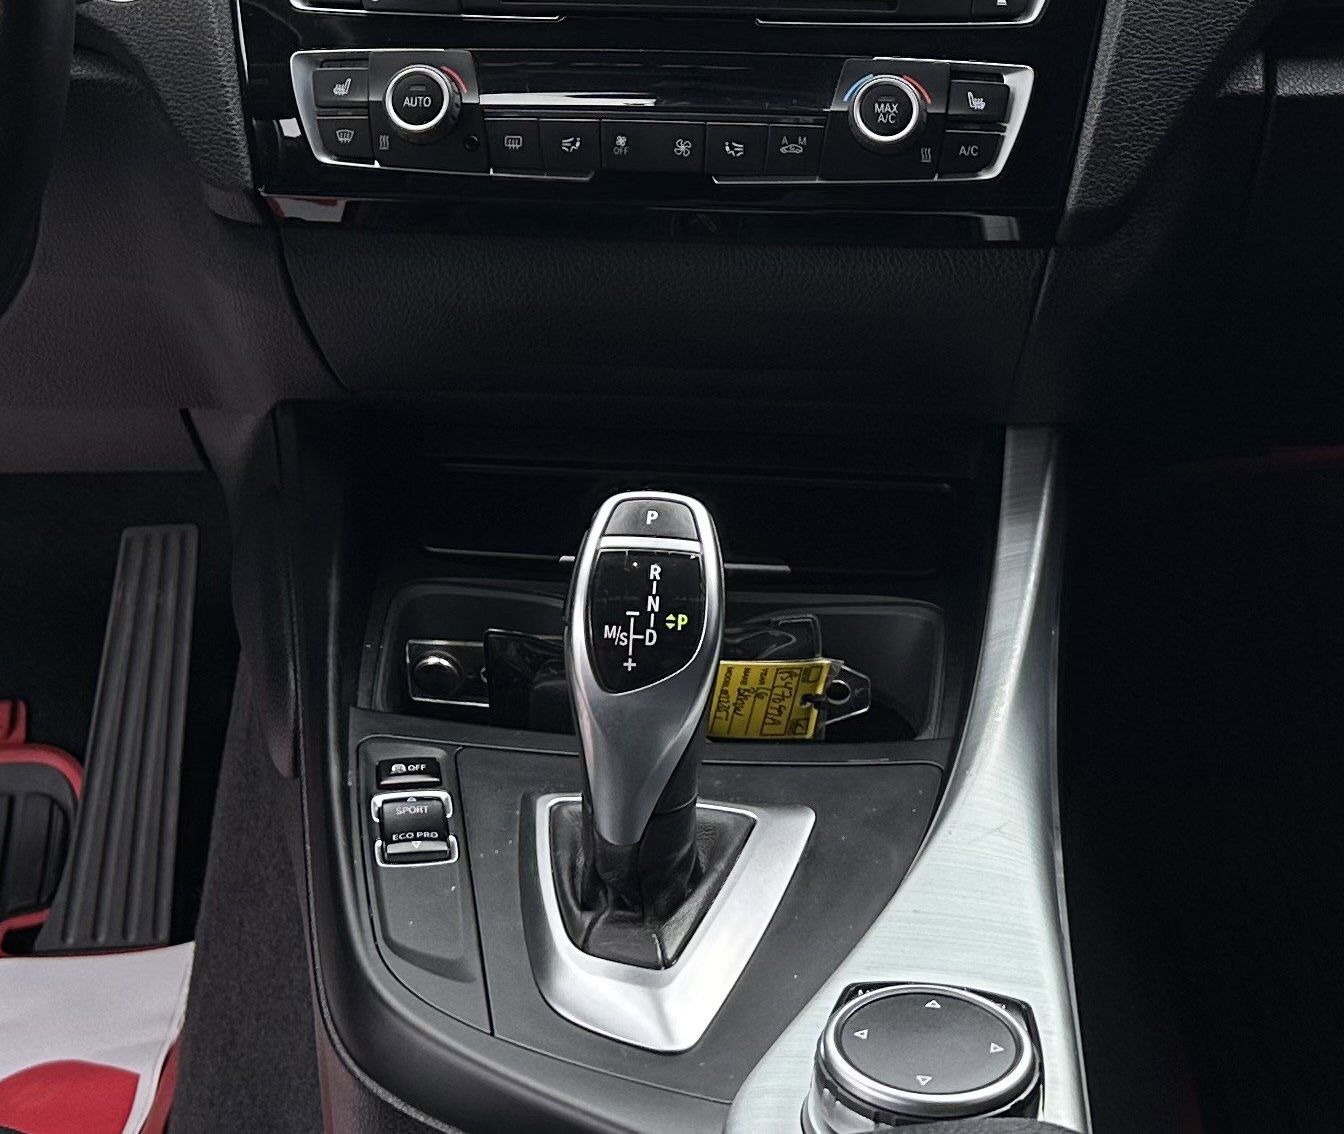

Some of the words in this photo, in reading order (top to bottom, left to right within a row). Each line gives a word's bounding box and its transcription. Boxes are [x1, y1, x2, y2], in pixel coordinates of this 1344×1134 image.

[403, 96, 432, 108] AUTO
[874, 103, 899, 114] MAX
[877, 113, 897, 124] A/C
[781, 136, 788, 145] A
[798, 136, 807, 145] M
[613, 146, 629, 155] OFF
[958, 145, 979, 157] A/C
[646, 510, 659, 525] P
[649, 564, 662, 581] R
[646, 595, 660, 613] N
[677, 614, 689, 631] P
[644, 629, 657, 646] D
[758, 667, 769, 685] YEAR
[407, 763, 427, 772] OFF
[396, 805, 429, 816] SPORT
[392, 831, 415, 841] ECO
